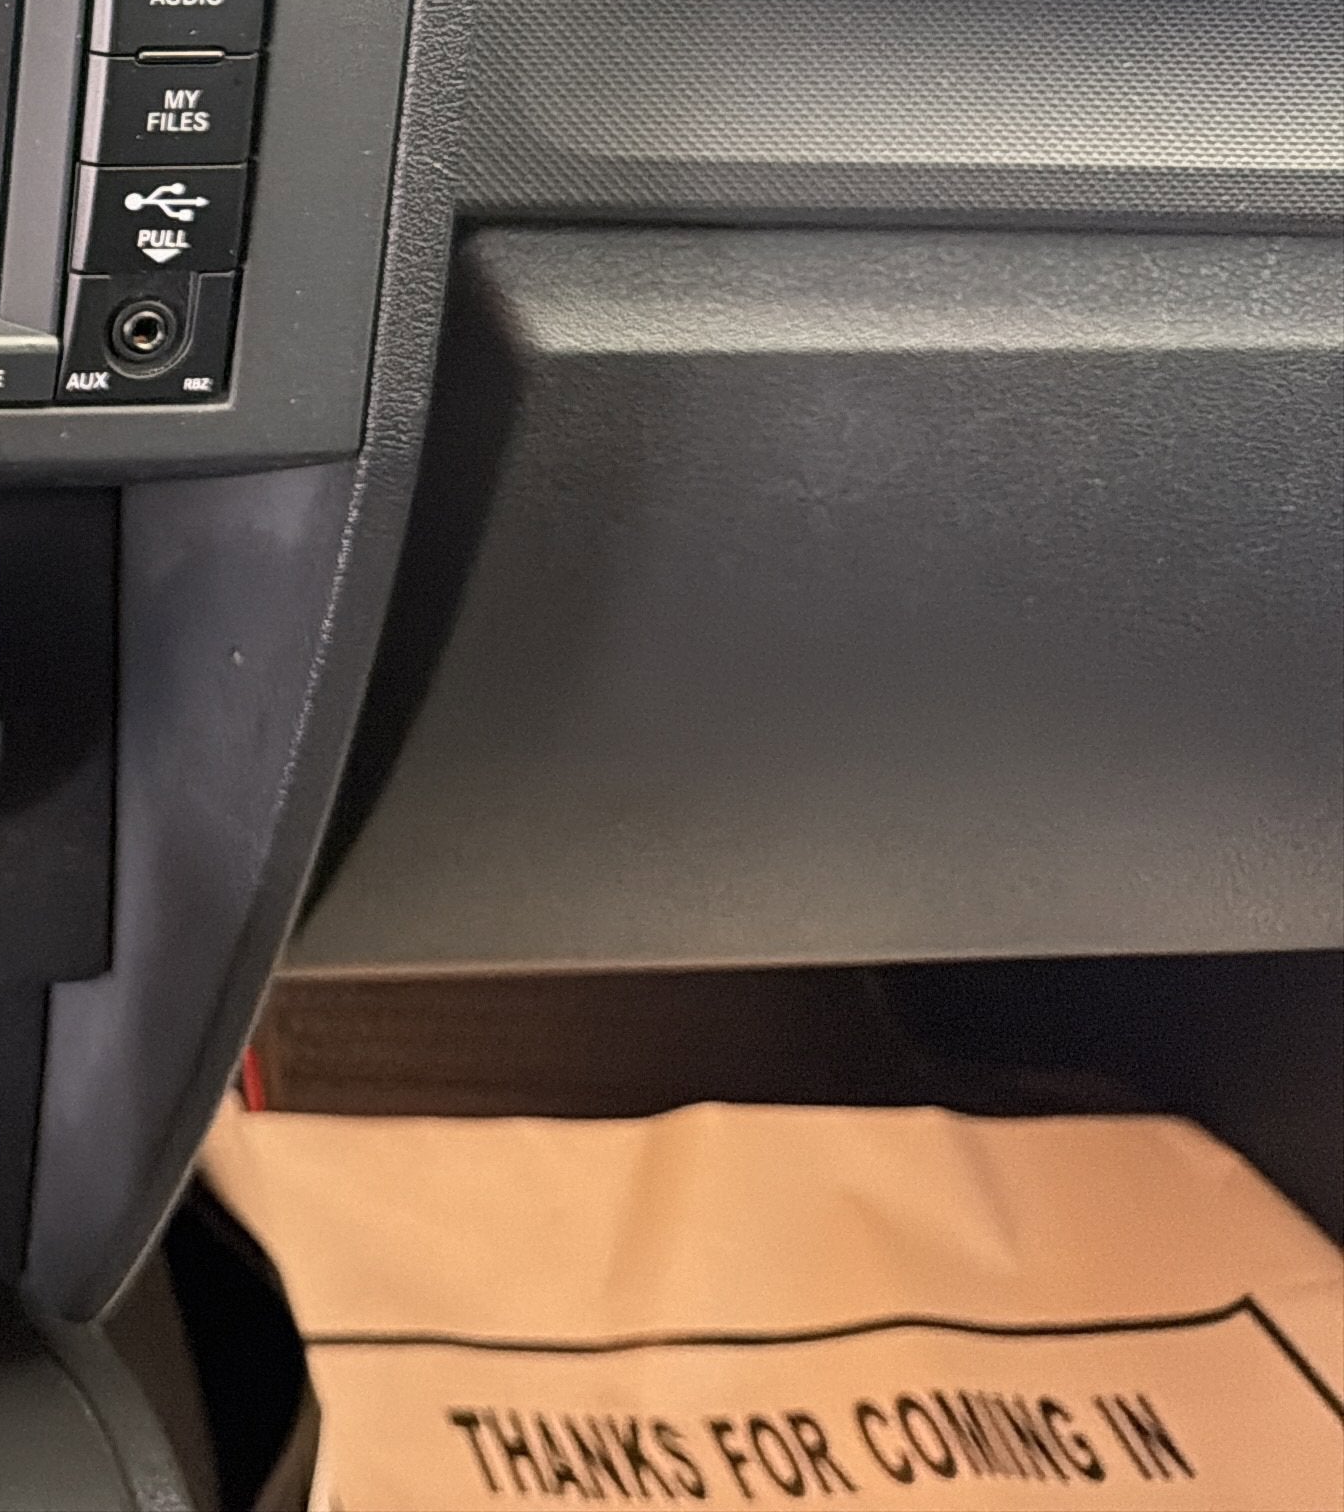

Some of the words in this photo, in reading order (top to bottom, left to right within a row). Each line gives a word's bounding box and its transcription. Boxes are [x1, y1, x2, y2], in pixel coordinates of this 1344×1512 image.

[164, 90, 202, 109] MY
[146, 112, 211, 132] FILES
[137, 229, 191, 248] PULL
[65, 372, 110, 390] AUX
[447, 1406, 708, 1499] THANKS
[705, 1410, 860, 1499] FOR
[853, 1390, 1105, 1484] COMING
[1092, 1391, 1196, 1480] IN
